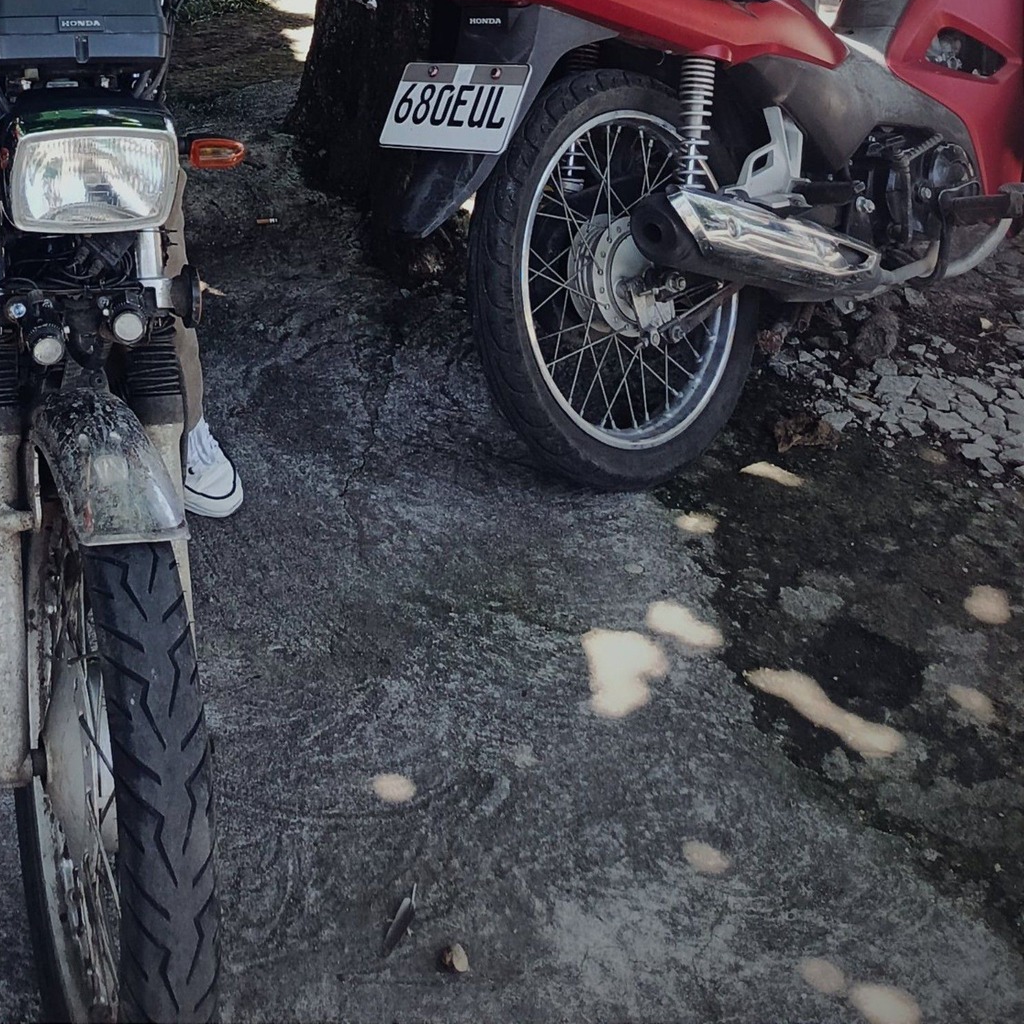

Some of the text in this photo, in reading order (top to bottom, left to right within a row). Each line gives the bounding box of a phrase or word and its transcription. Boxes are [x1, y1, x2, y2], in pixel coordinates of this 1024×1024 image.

[61, 19, 101, 27] HONDA
[469, 17, 502, 25] HONDA
[394, 83, 505, 129] 680EUL
